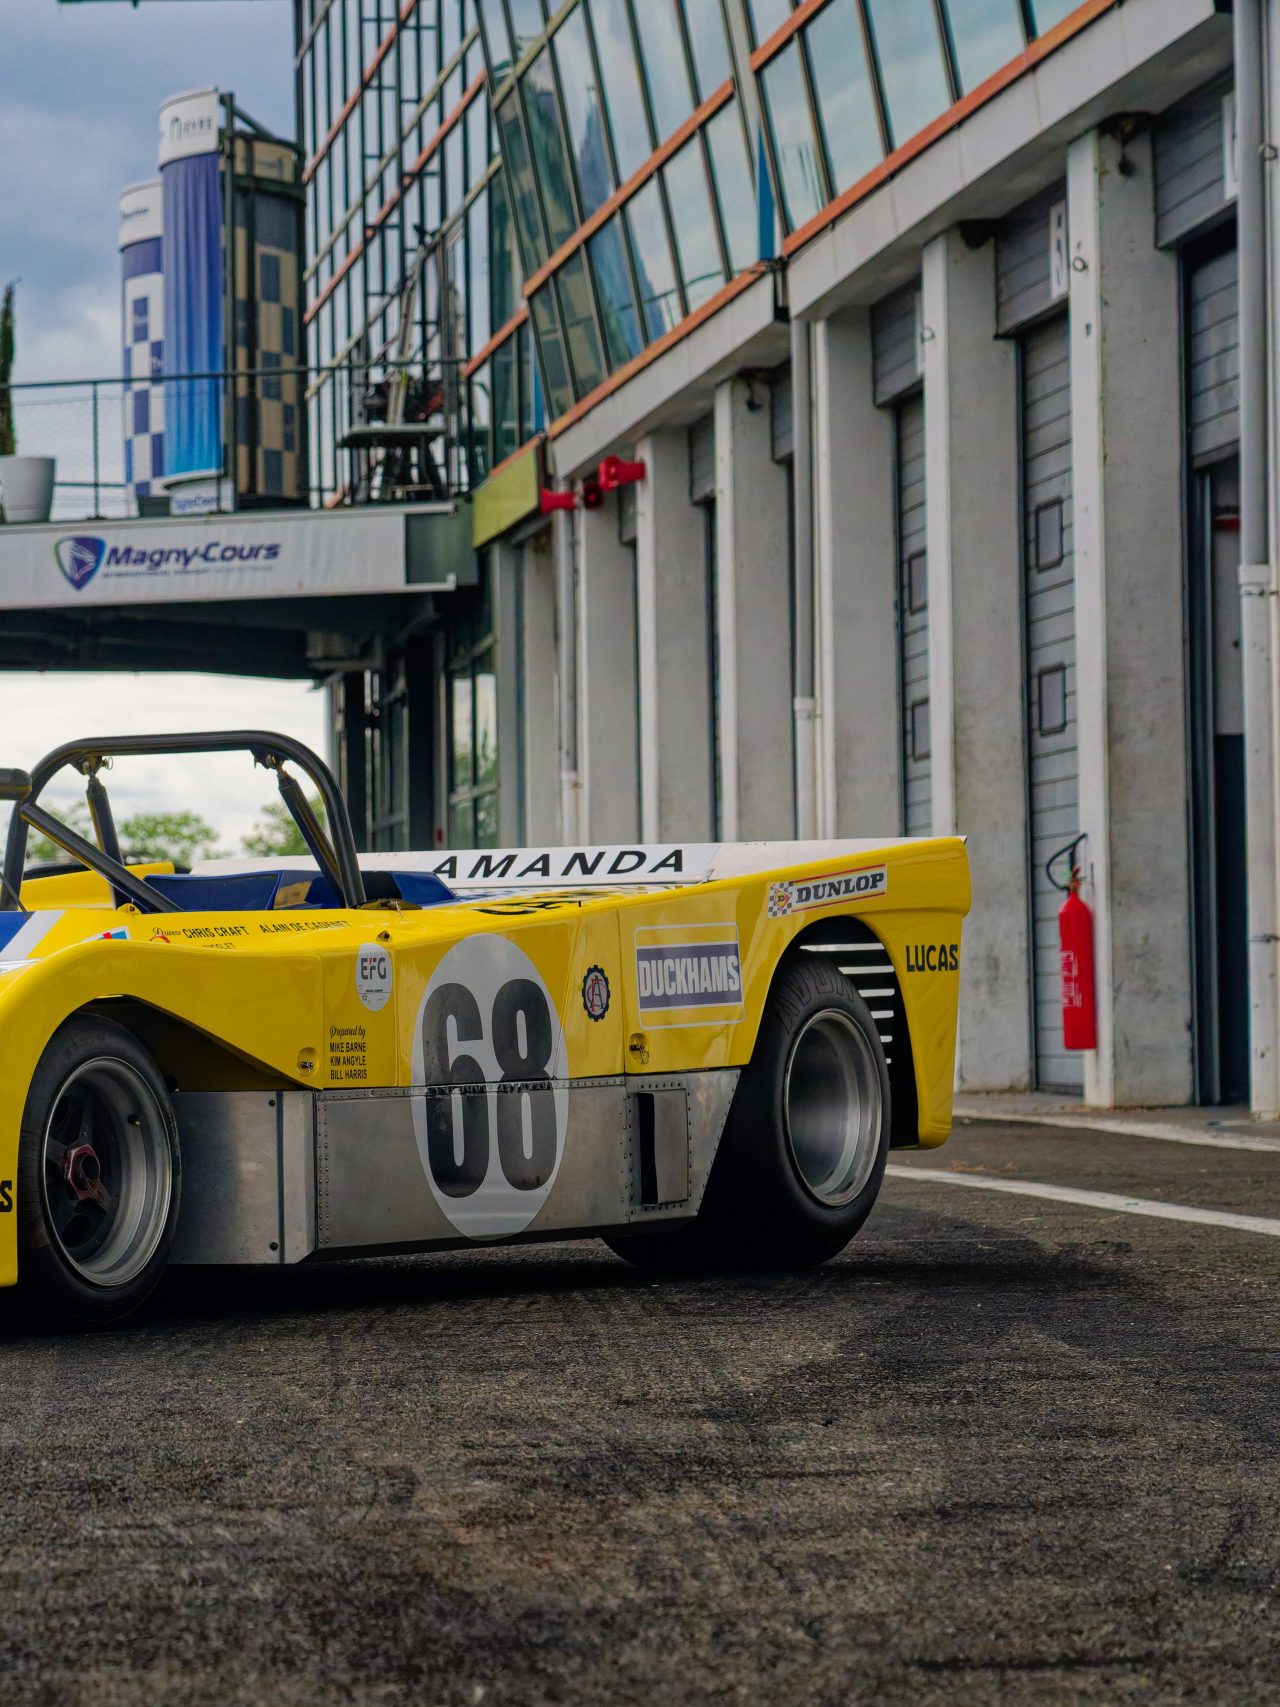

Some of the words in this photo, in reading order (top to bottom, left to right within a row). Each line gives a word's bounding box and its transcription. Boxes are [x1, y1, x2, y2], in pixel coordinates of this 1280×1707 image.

[432, 849, 683, 878] AMANDA
[796, 872, 885, 904] DUNLOP
[182, 927, 216, 939] CHRIS
[213, 925, 250, 937] CRAFT
[259, 923, 292, 934] ALAIN
[289, 922, 308, 932] DE
[360, 957, 387, 980] EFG
[905, 944, 959, 972] LUCAS
[638, 954, 740, 997] DUCKHAMS
[329, 1042, 345, 1053] MIKE
[330, 1056, 341, 1067] KIM
[330, 1069, 344, 1080] BILL
[344, 1069, 368, 1080] HARRIS
[422, 978, 558, 1199] 68
